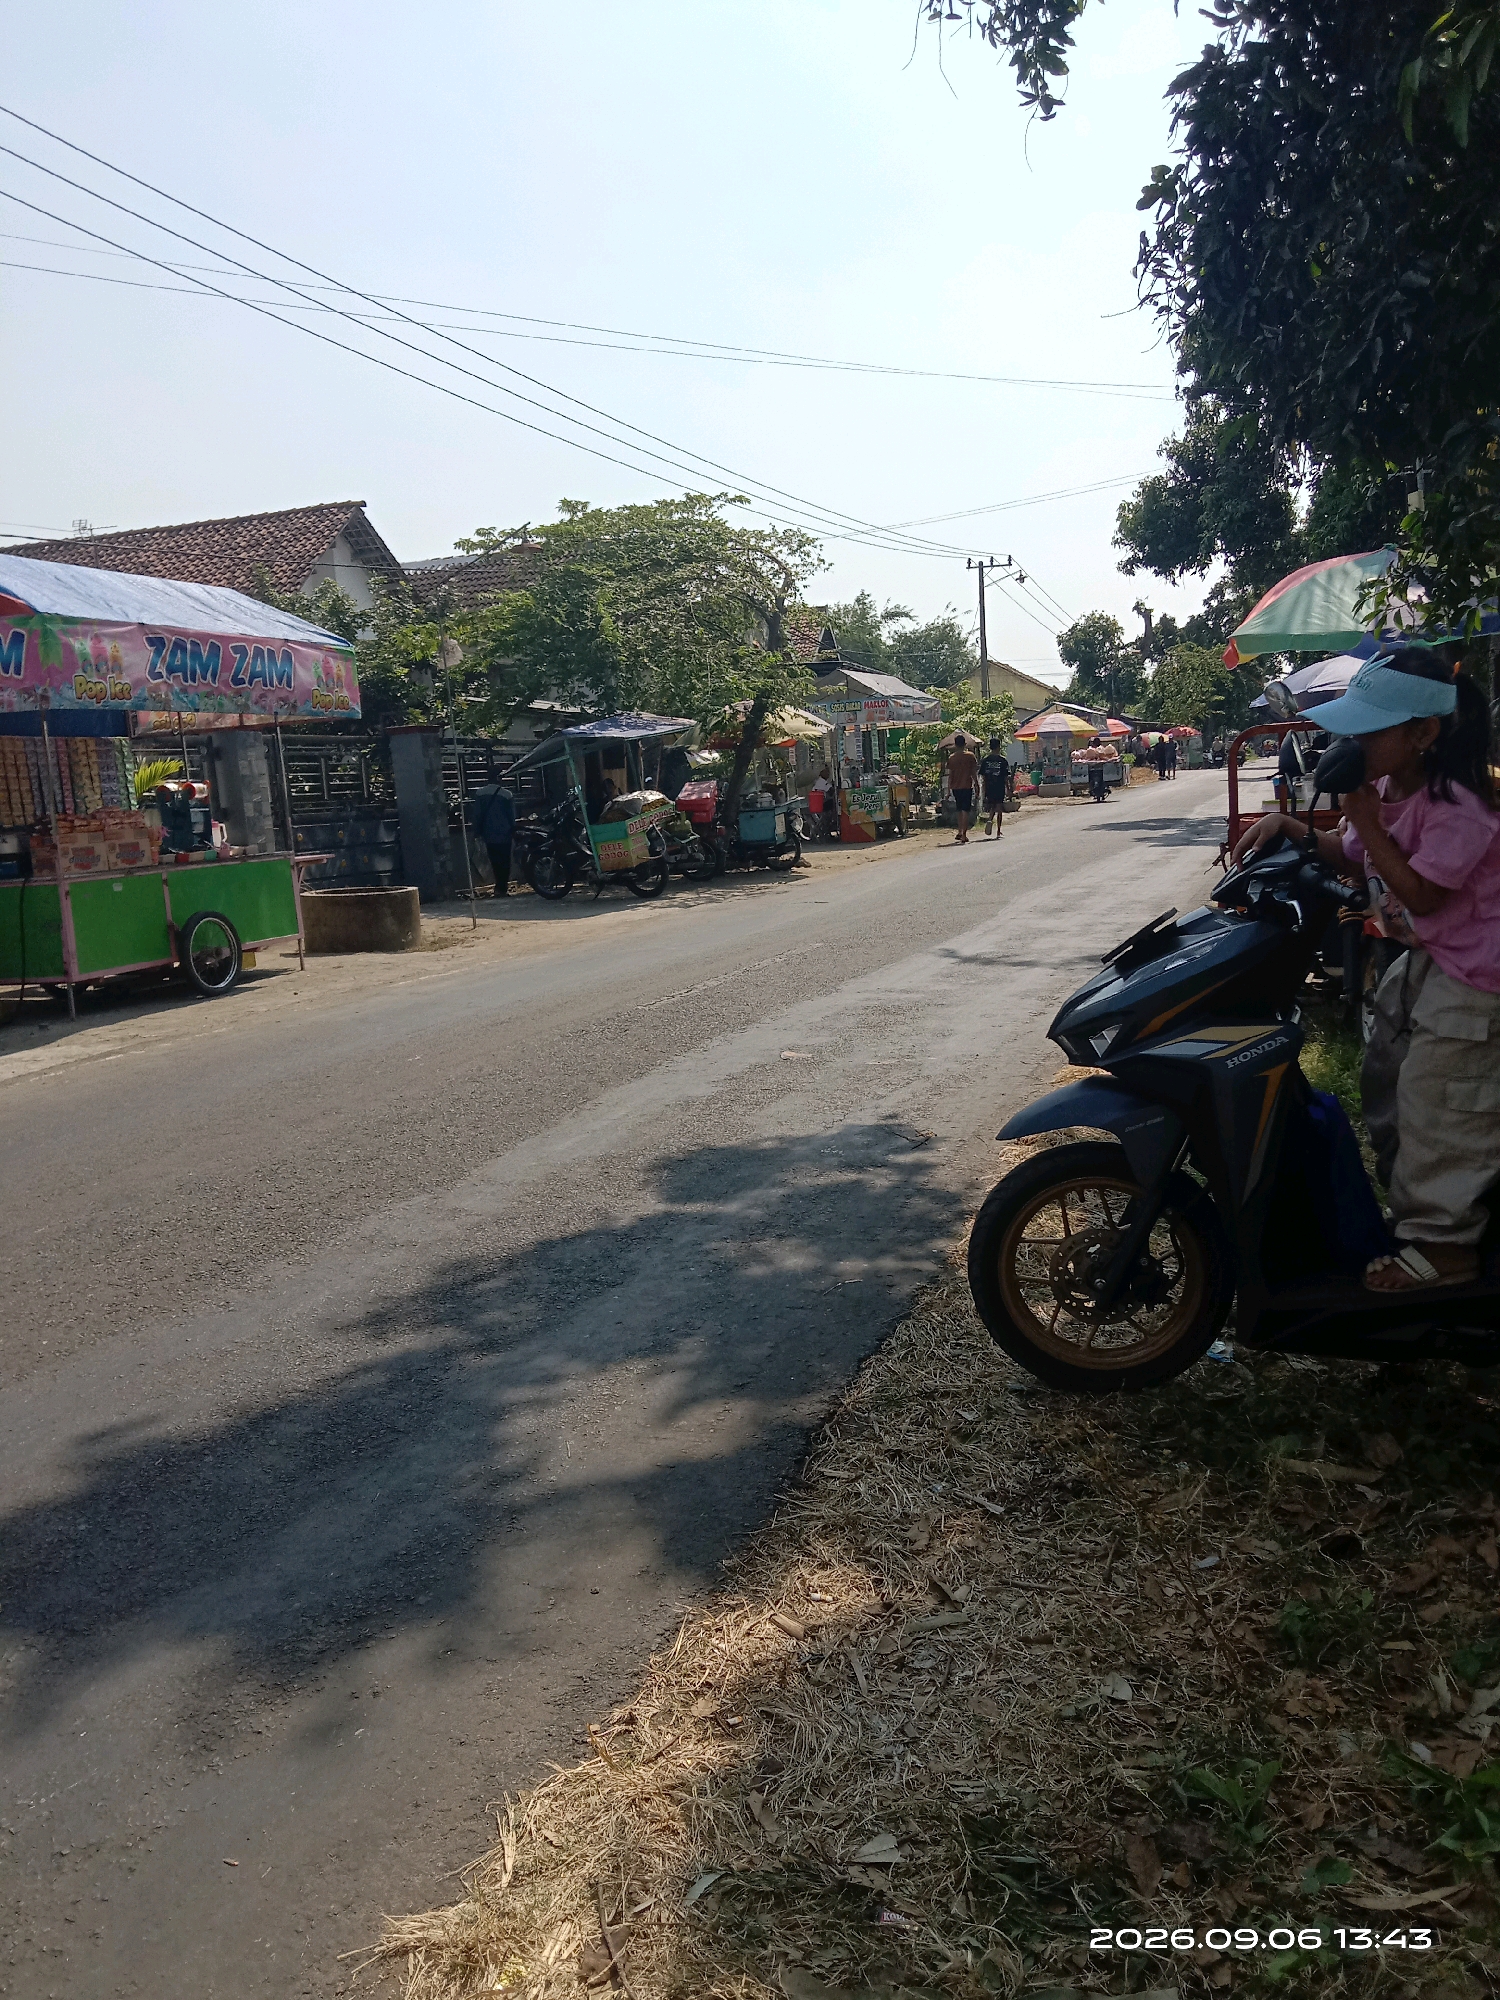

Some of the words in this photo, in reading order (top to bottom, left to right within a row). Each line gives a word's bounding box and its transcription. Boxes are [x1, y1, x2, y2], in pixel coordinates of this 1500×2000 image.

[143, 632, 222, 687] ZAM
[228, 642, 295, 691] ZAM
[73, 674, 107, 704] Pop
[107, 674, 133, 700] Ice
[312, 687, 334, 713] Pop
[334, 688, 350, 710] Ice
[830, 702, 845, 713] SOSIS
[852, 794, 861, 803] Es
[628, 817, 648, 834] DELE
[598, 850, 629, 861] GODOG
[601, 843, 624, 852] DELE
[1225, 1036, 1290, 1069] HONDA
